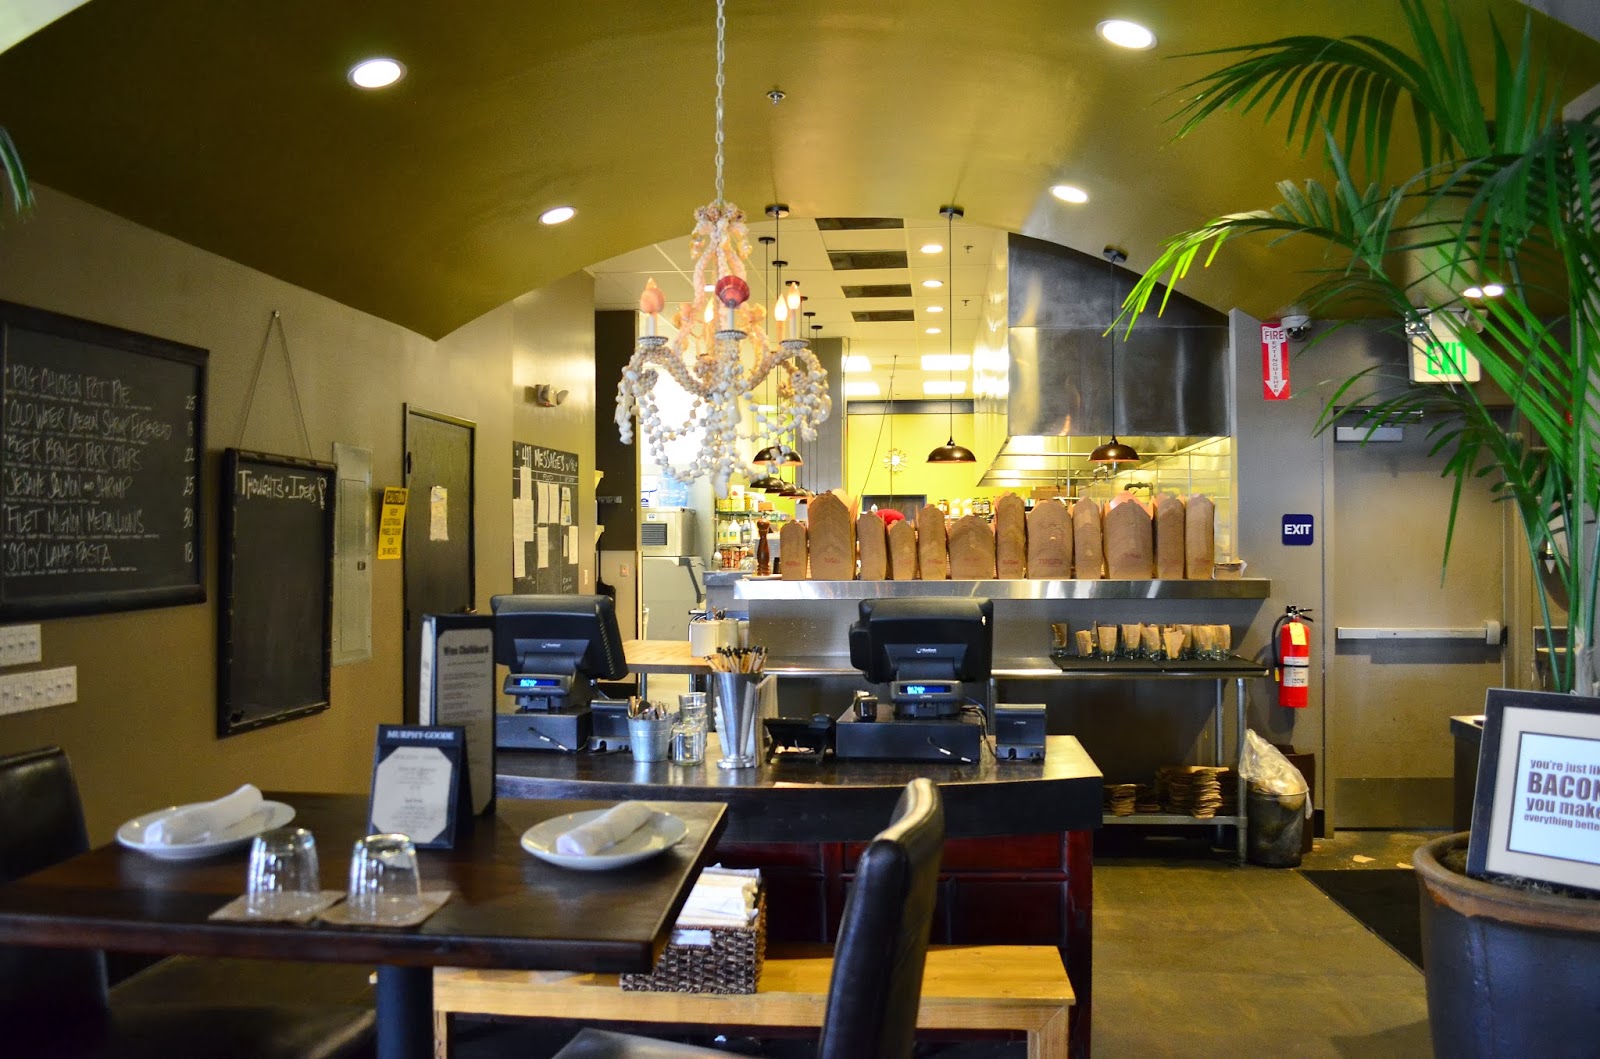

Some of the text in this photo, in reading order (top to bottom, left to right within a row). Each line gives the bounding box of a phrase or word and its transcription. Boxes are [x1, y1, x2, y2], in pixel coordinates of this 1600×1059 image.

[1264, 330, 1285, 340] FIRE
[1271, 341, 1280, 393] EXTINGUISHER
[1426, 341, 1468, 375] EXIT
[13, 364, 38, 390] BIG
[86, 376, 110, 400] POT
[113, 379, 132, 404] PIE
[534, 448, 565, 472] MESSAGES
[8, 505, 45, 533] FILET
[1284, 523, 1312, 535] EXIT
[1530, 760, 1563, 771] you're
[1565, 761, 1587, 775] just
[1525, 797, 1556, 813] you
[1523, 814, 1600, 832] everything bette
